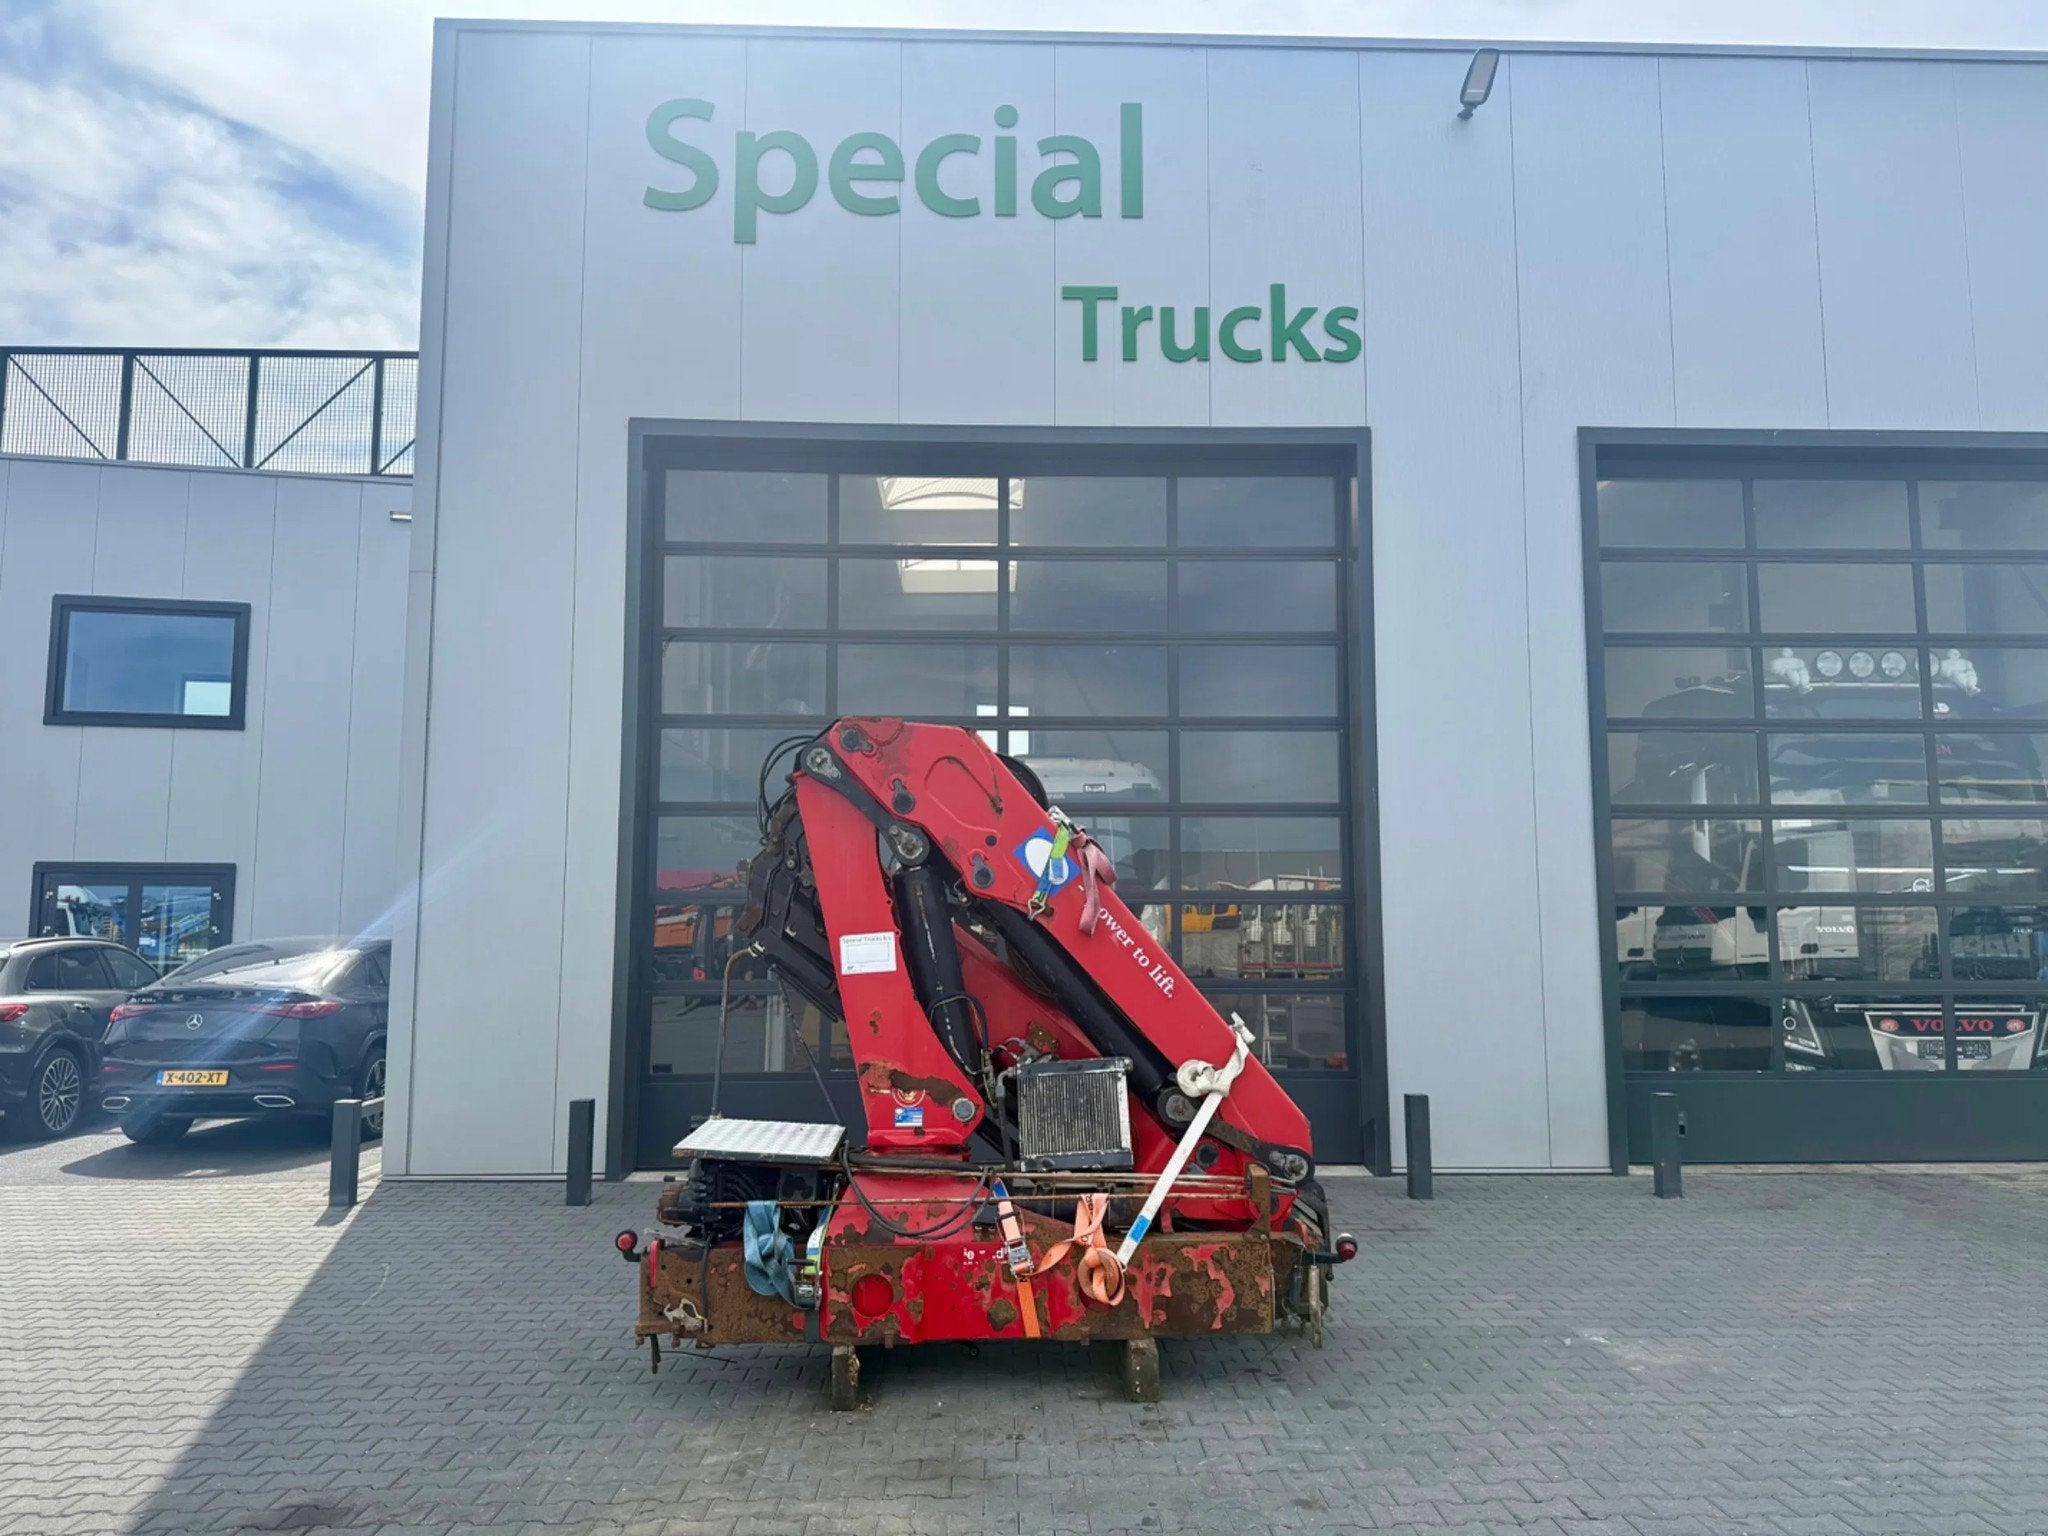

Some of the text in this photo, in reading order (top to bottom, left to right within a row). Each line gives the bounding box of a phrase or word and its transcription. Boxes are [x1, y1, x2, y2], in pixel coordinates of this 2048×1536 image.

[644, 99, 1143, 243] Special
[1061, 284, 1363, 362] Trucks
[1815, 925, 1855, 933] VOLVO
[1099, 907, 1175, 998] ower to lift.
[1911, 1018, 1995, 1032] VOVO
[165, 1072, 223, 1084] X-402-XT
